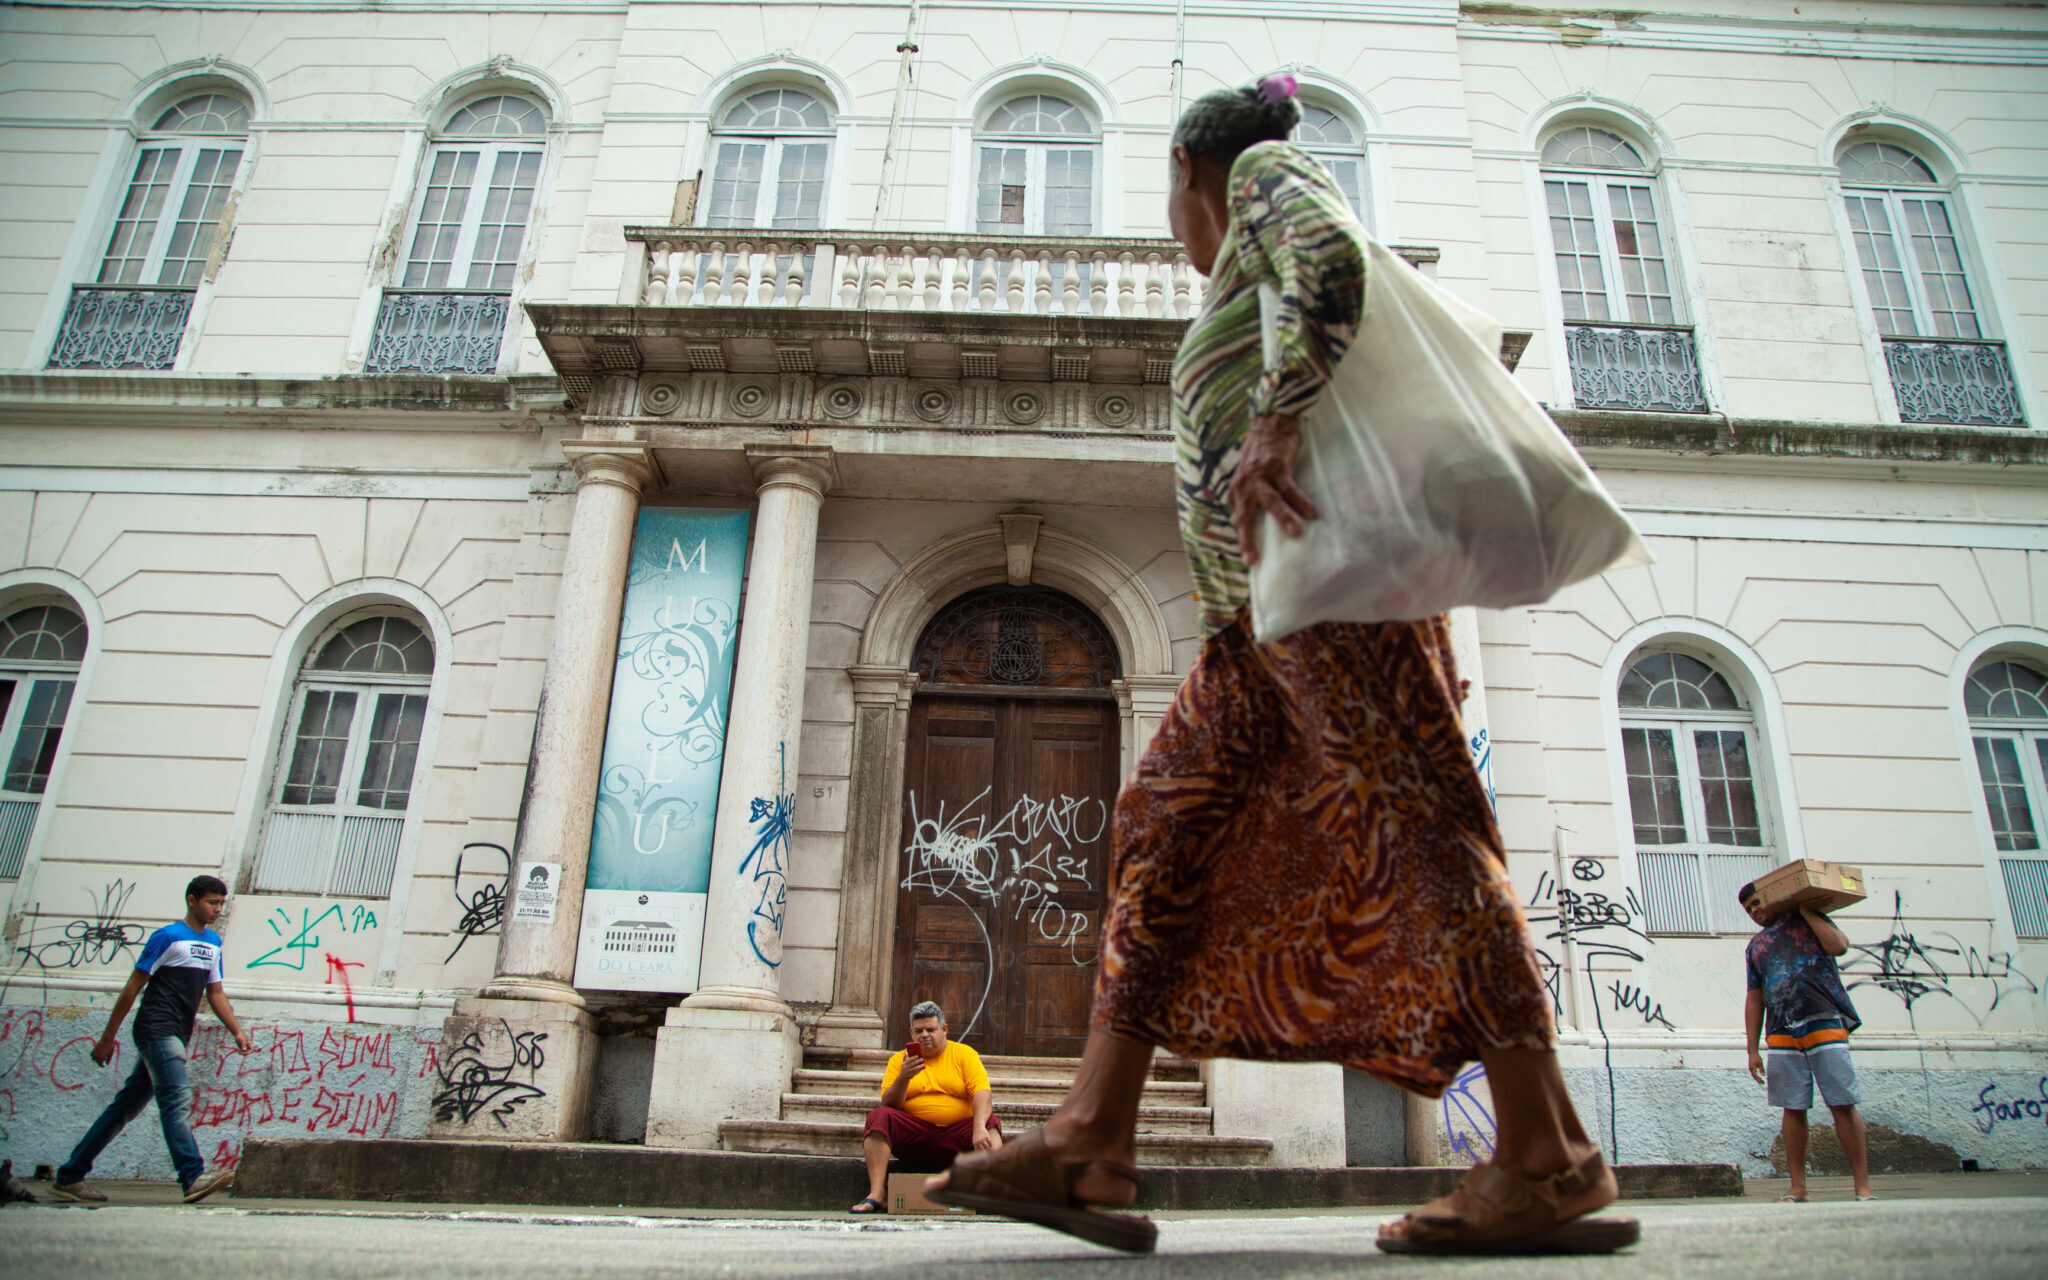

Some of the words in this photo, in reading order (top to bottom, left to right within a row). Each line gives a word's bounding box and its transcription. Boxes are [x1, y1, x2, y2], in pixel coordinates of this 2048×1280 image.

[633, 536, 711, 855] MUEU
[598, 958, 623, 972] DO
[627, 957, 674, 974] CEARÁ
